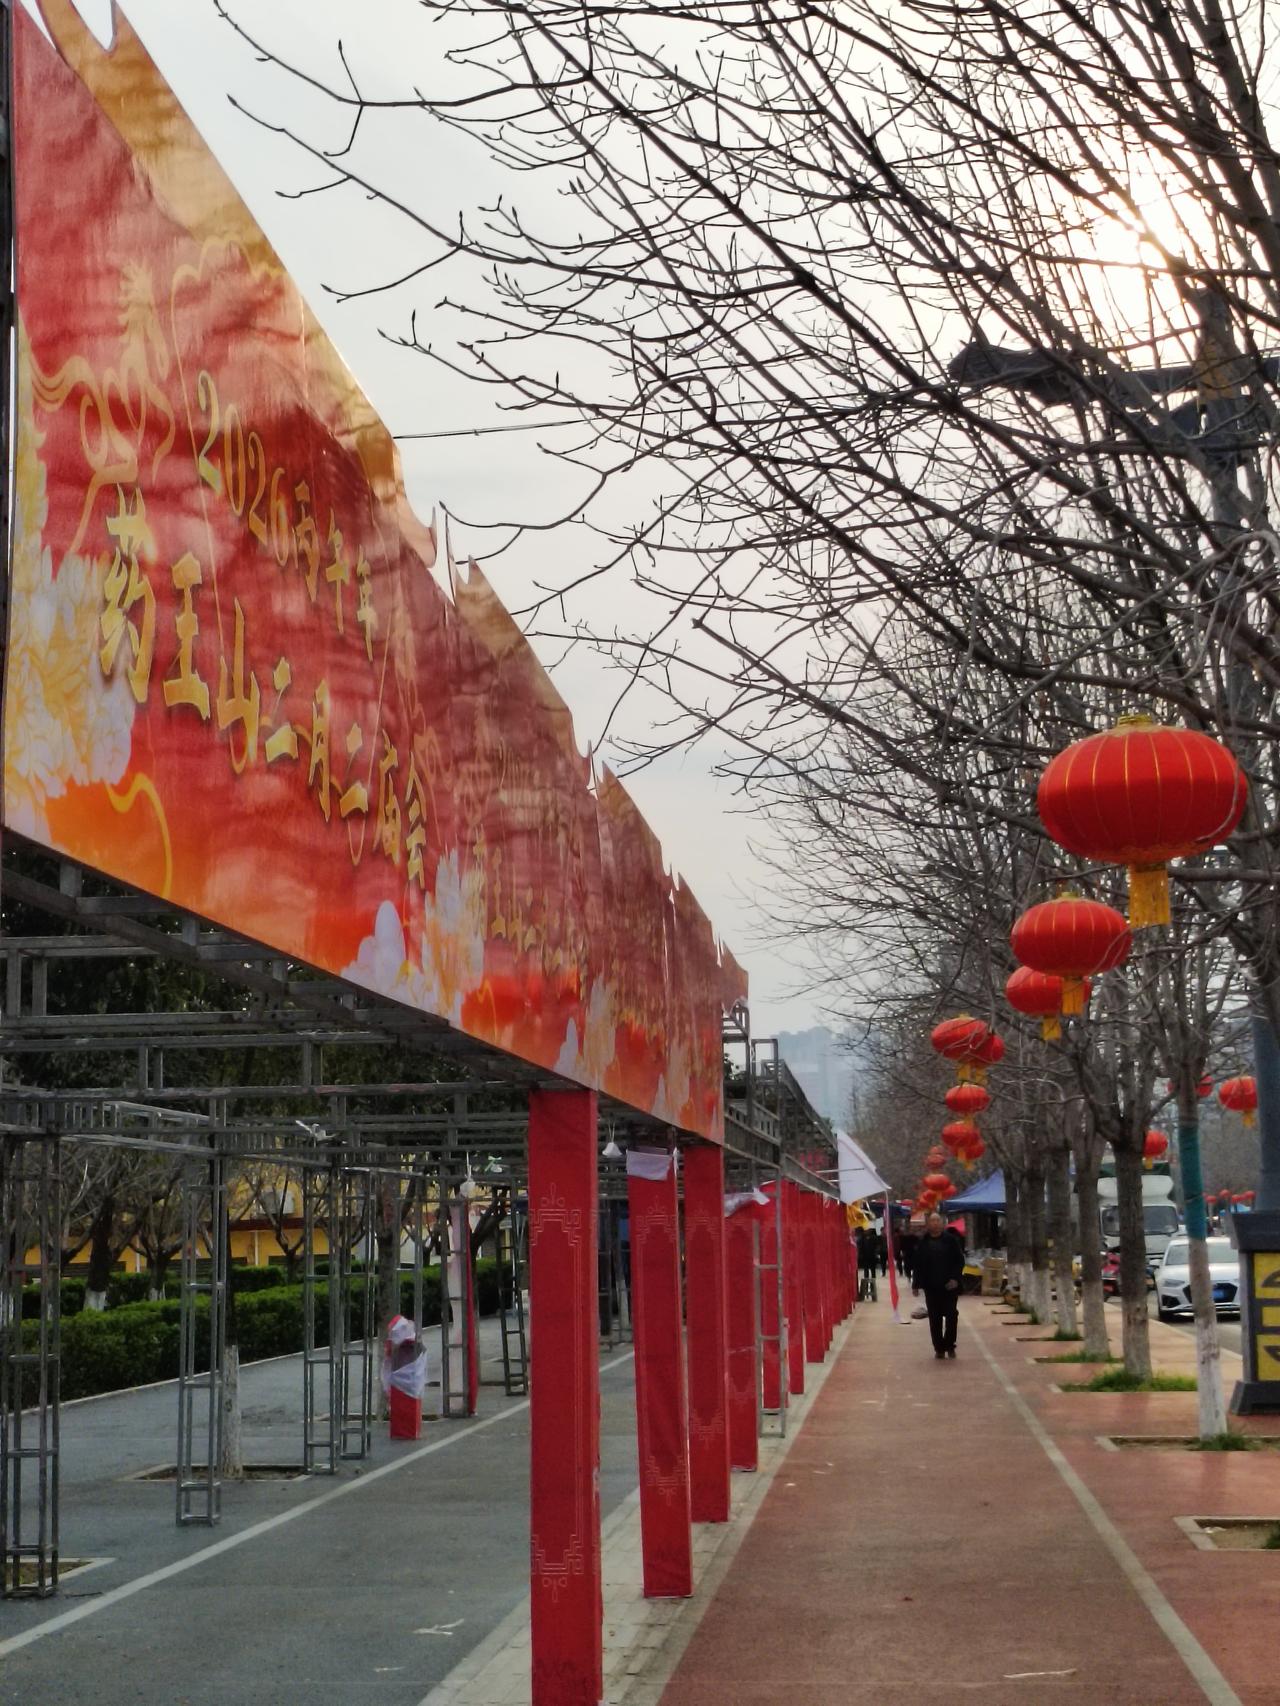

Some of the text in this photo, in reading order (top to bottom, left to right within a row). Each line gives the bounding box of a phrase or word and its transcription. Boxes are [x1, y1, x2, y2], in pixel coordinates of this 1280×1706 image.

[98, 482, 426, 889] 药王山二月二庙会
[197, 369, 378, 662] 2026丙午年
